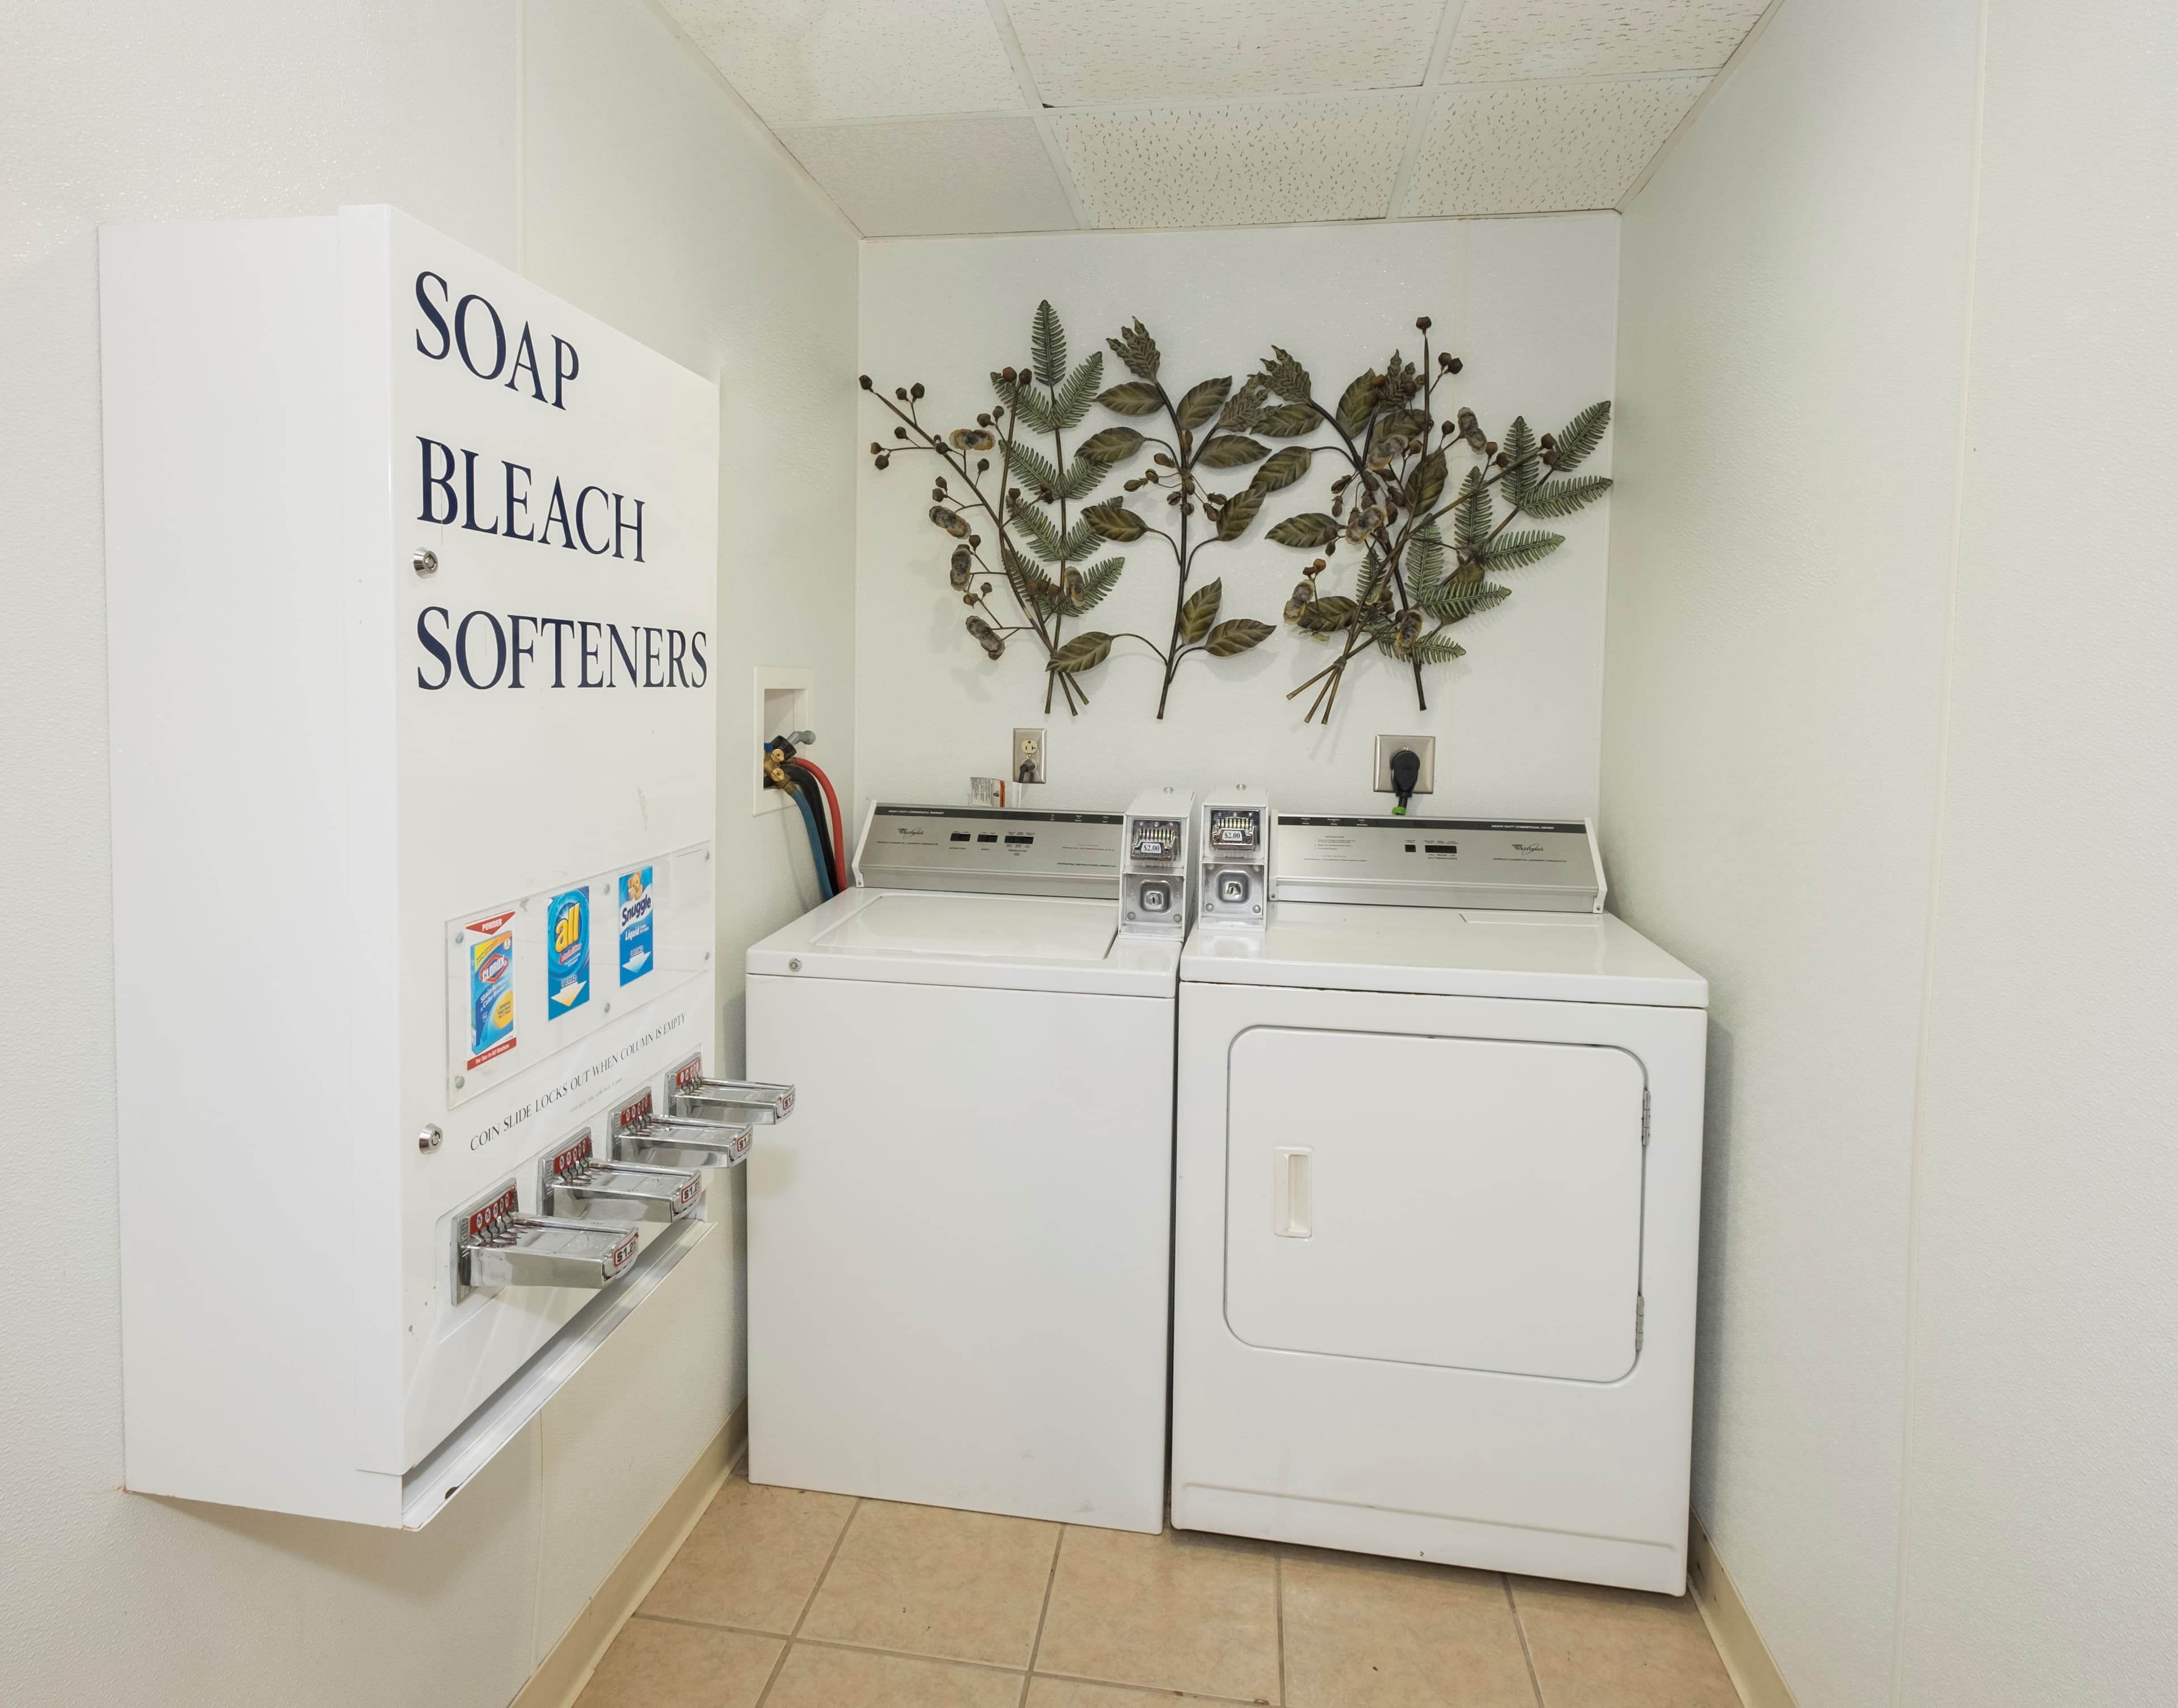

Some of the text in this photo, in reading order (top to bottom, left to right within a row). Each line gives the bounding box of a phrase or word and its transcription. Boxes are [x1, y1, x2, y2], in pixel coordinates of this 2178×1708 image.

[416, 271, 579, 410] SOAP
[416, 436, 645, 563] BLEACH
[417, 606, 707, 690] SOFTENERS
[898, 828, 924, 836] Whirlpool
[1512, 844, 1544, 853] Whirlpool
[482, 918, 502, 931] POWDER
[622, 894, 651, 927] Snuggle
[555, 902, 580, 953] all
[625, 925, 640, 941] Liquid
[483, 955, 506, 982] CLOROX
[470, 1123, 500, 1150] COIN
[503, 1104, 532, 1131] SLIDE
[535, 1082, 568, 1112] LOCKS
[570, 1069, 590, 1090] OUT
[592, 1052, 618, 1077] WHEN
[621, 1032, 653, 1060] COLUMN
[656, 1026, 662, 1039] IS
[664, 1012, 686, 1035] EMPTY
